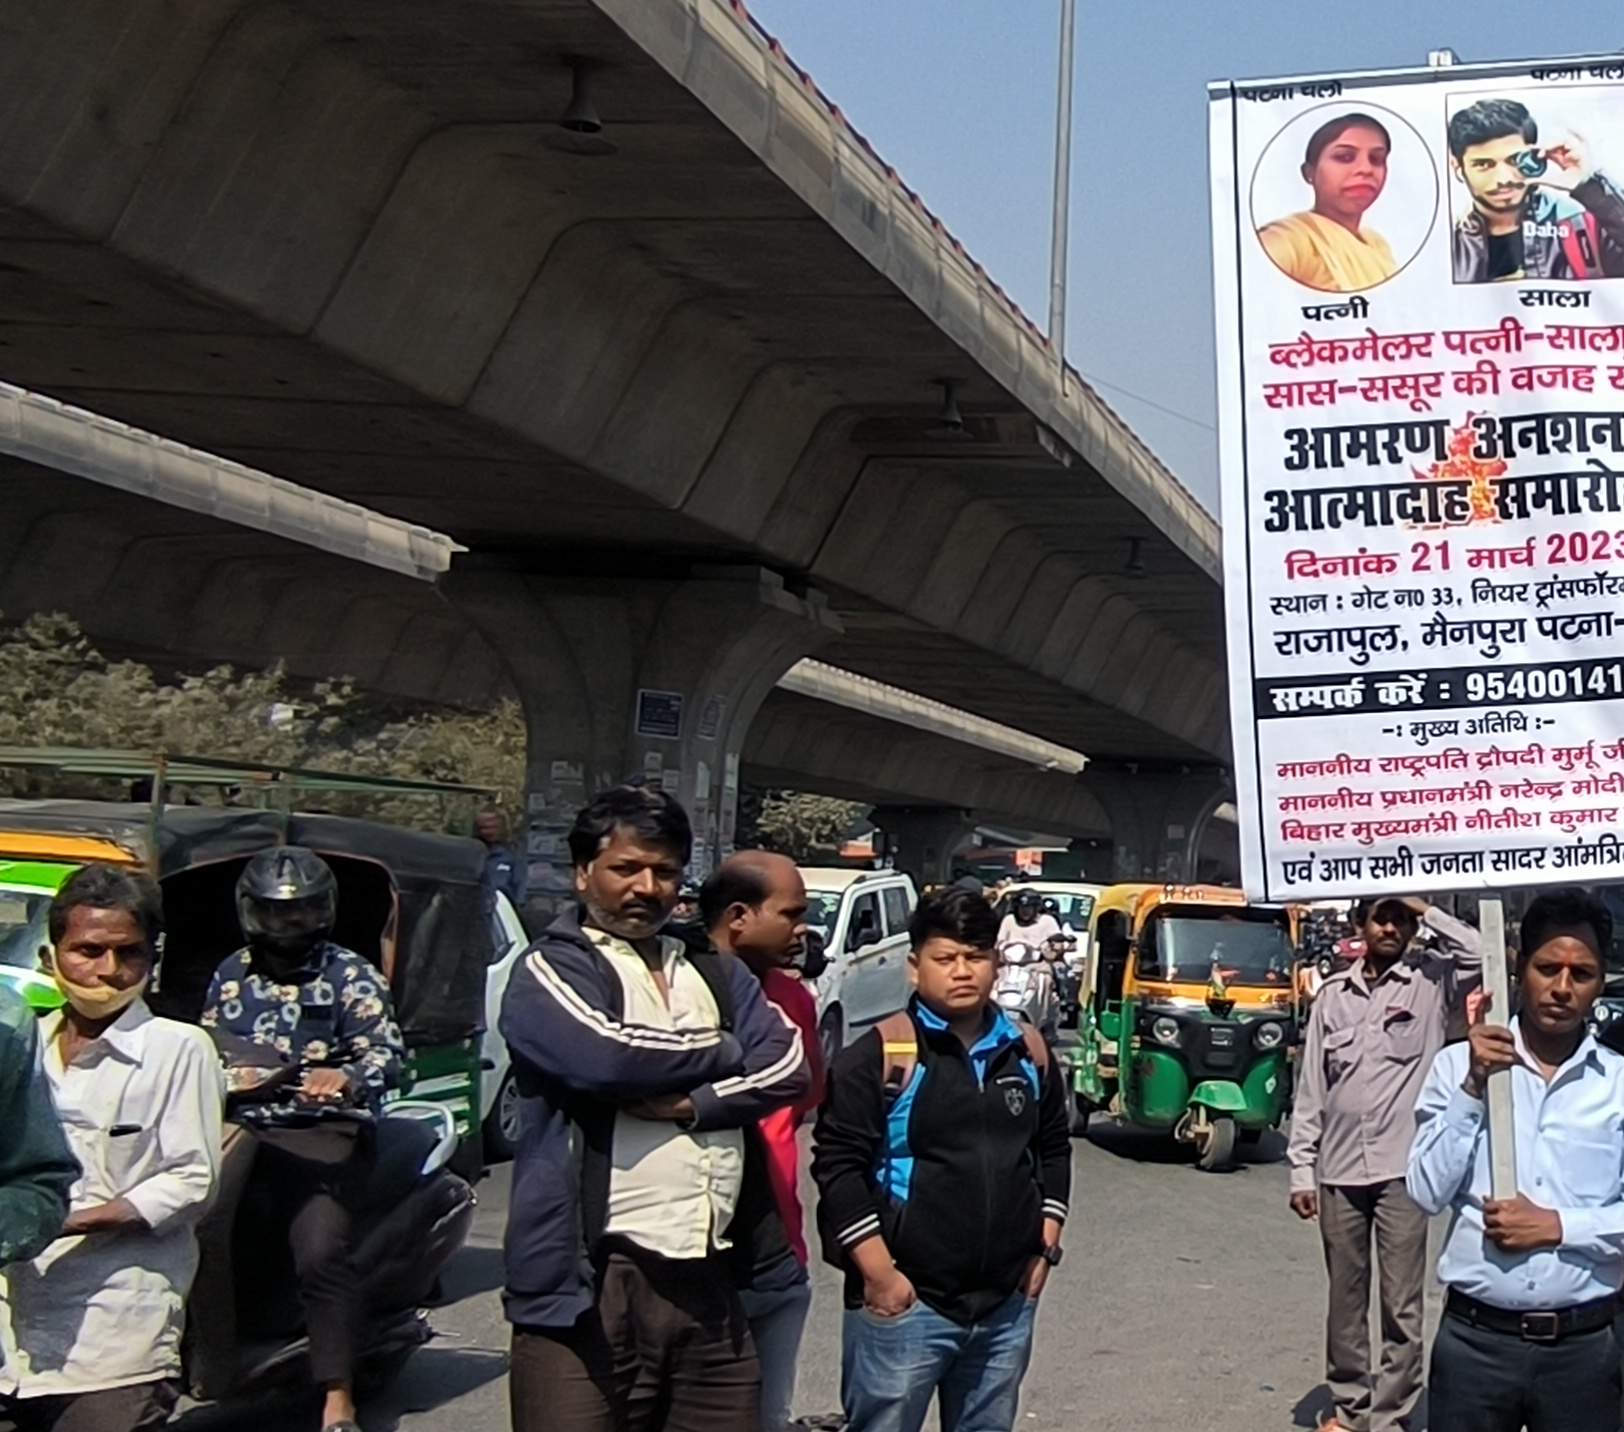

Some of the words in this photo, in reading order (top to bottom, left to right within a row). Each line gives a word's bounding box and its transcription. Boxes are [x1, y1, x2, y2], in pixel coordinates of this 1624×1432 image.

[1302, 297, 1368, 321] पत्नी
[1518, 290, 1591, 307] साला
[1269, 328, 1435, 367] ब्लैकमेलर
[1264, 372, 1444, 411] सास-ससूर
[1453, 360, 1501, 396] की
[1512, 365, 1596, 392] वजह
[1284, 420, 1449, 470] आमरण
[1474, 412, 1624, 458] अनशन
[1264, 479, 1472, 533] आत्मादाह
[1284, 548, 1399, 580] दिनांक
[1411, 541, 1449, 573] 21
[1466, 538, 1536, 569] मार्च
[1270, 595, 1328, 616] स्थान
[1352, 589, 1388, 611] गेट
[1471, 578, 1530, 604] नियर
[1274, 624, 1408, 664] राजापुल,
[1422, 611, 1527, 659] मैनपुरा
[1270, 677, 1366, 712] सम्पर्क
[1375, 668, 1426, 706] करें
[1410, 719, 1459, 746] मुख्य
[1465, 711, 1528, 736] अतिथि
[1276, 755, 1371, 780] माननीय
[1379, 747, 1469, 780] राष्ट्रपति
[1476, 743, 1545, 772] द्रौपदी
[1553, 740, 1599, 769] मुर्मू
[1279, 789, 1372, 813] माननीय
[1382, 780, 1492, 810] प्रधानमंत्री
[1500, 779, 1563, 800] नरेन्द्र
[1280, 819, 1346, 842] बिहार
[1352, 812, 1458, 846] मुख्यमंत्री
[1465, 806, 1540, 832] नीतीश
[1550, 805, 1617, 831] कुमार
[1282, 853, 1315, 885] एवं
[1319, 854, 1362, 881] आप
[1369, 846, 1414, 879] सभी
[1419, 849, 1484, 876] जनता
[1492, 844, 1548, 872] सादर
